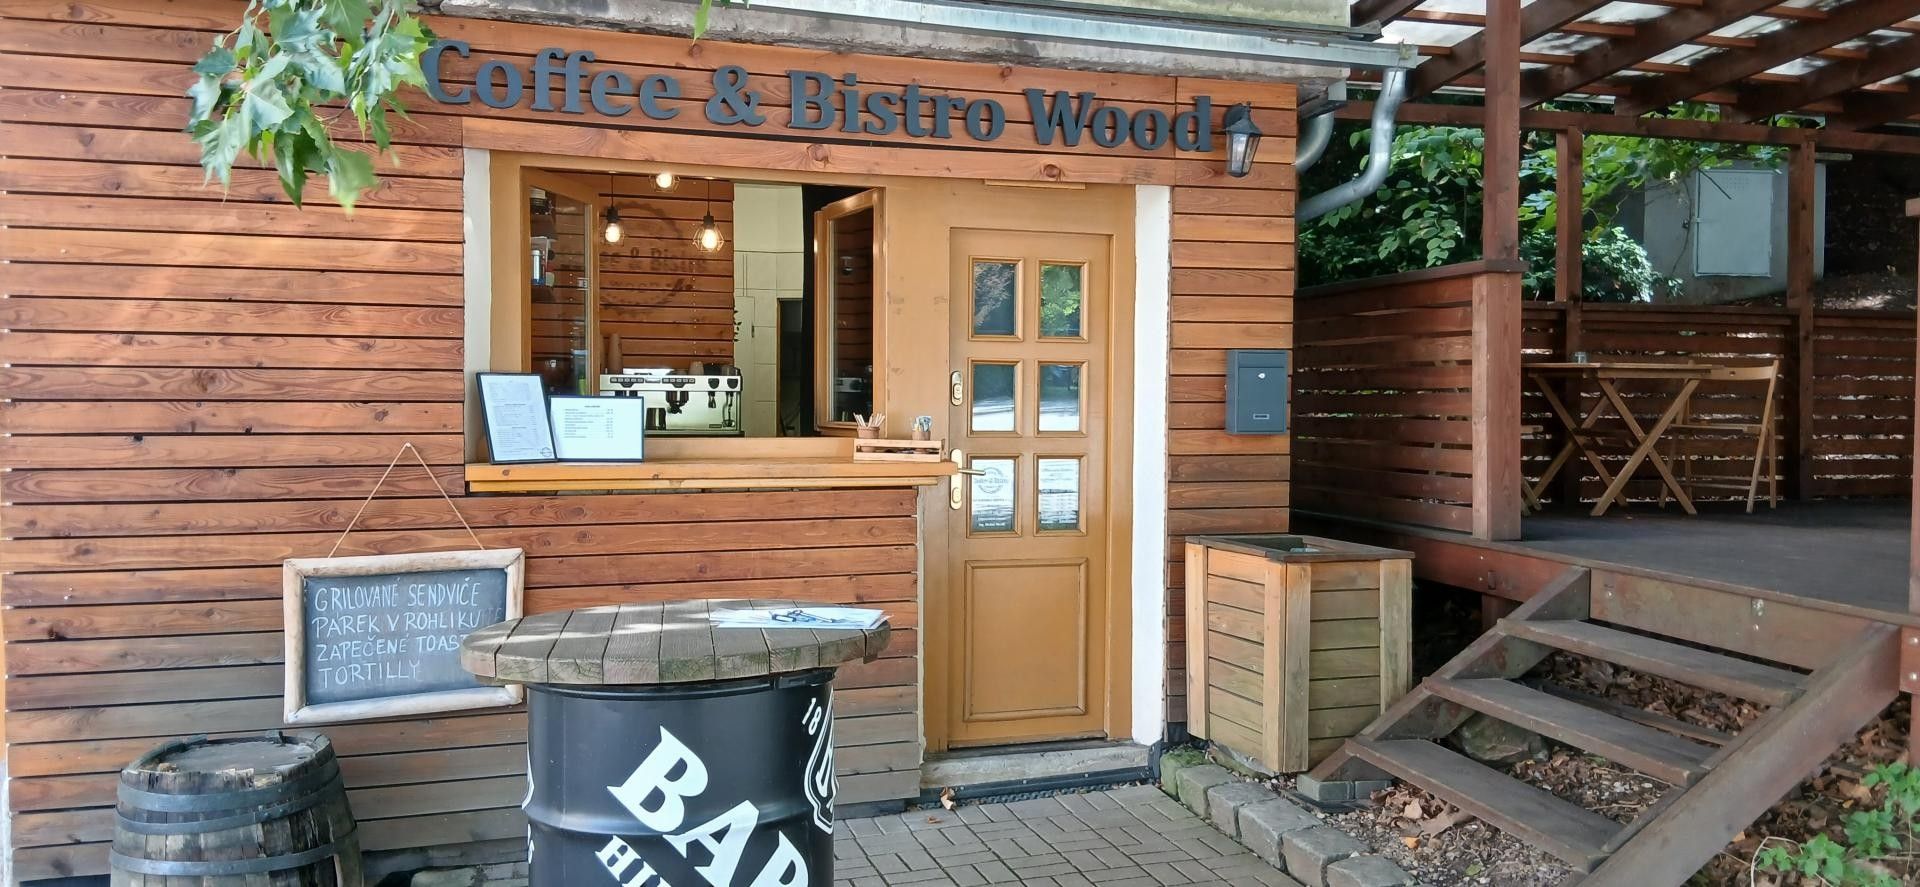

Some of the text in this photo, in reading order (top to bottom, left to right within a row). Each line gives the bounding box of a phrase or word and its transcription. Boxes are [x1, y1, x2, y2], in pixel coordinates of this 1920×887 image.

[419, 39, 1214, 154] Coffee & Bistro Wood
[315, 577, 480, 611] GRILOVANÉ SENDVIČE
[387, 613, 400, 631] V
[404, 611, 480, 631] ROHLIKU
[316, 634, 407, 661] ZAPEČENÉ
[318, 660, 420, 688] TORTILLY
